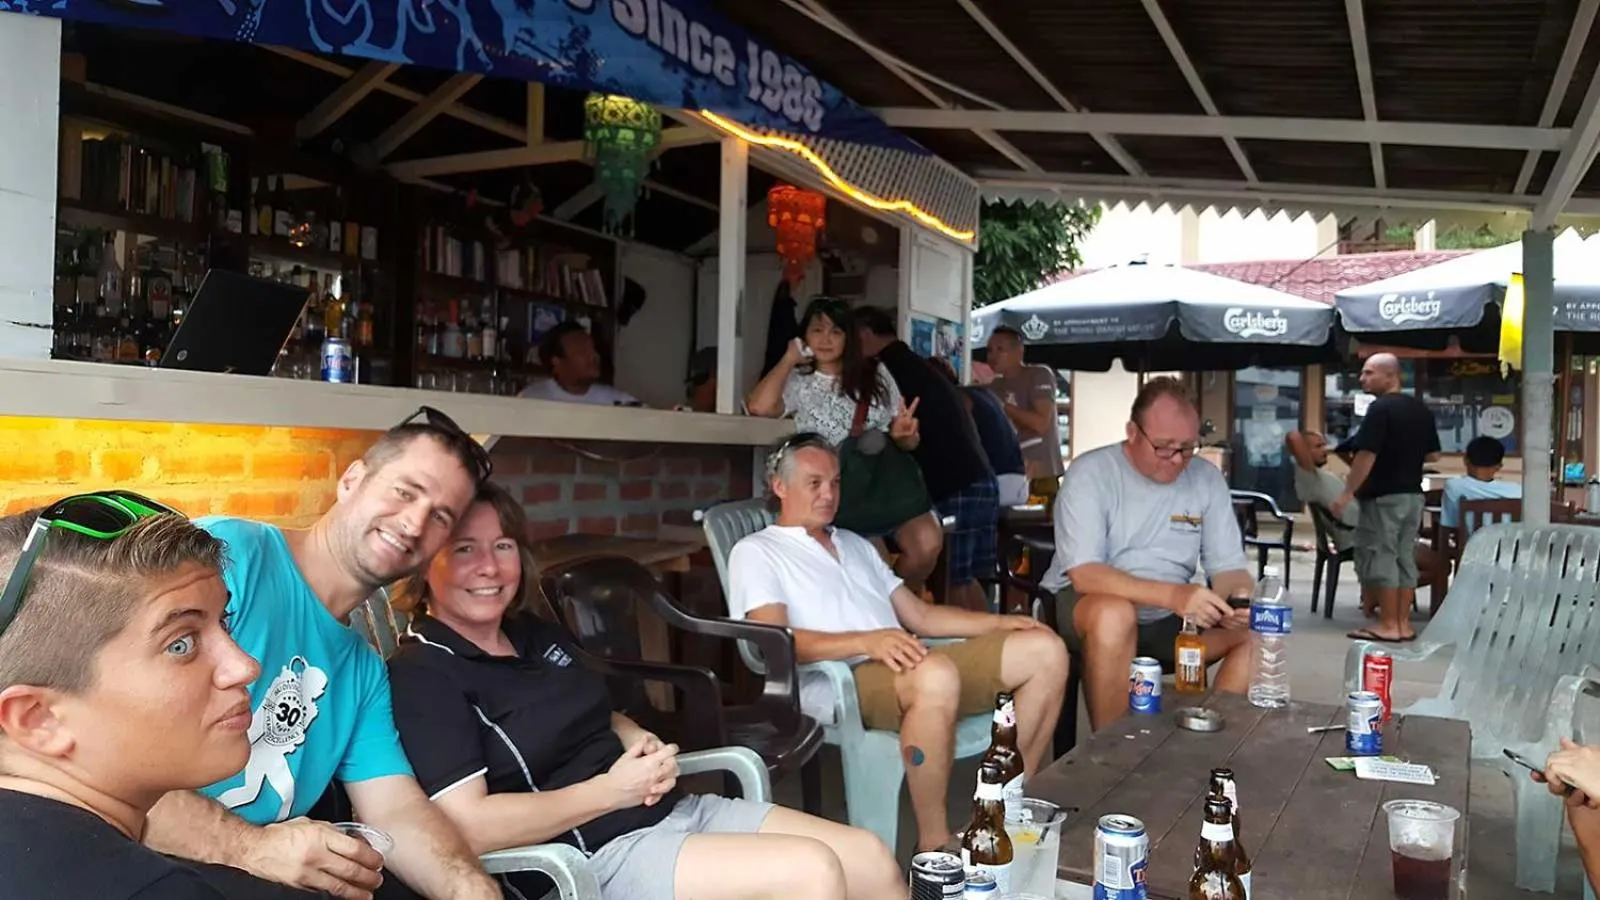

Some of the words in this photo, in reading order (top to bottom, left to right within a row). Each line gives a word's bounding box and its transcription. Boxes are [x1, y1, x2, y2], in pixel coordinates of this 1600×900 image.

[747, 40, 825, 132] 1986
[1223, 308, 1288, 338] Carlsberg
[1379, 291, 1441, 325] Carlsberg
[275, 702, 301, 728] 30
